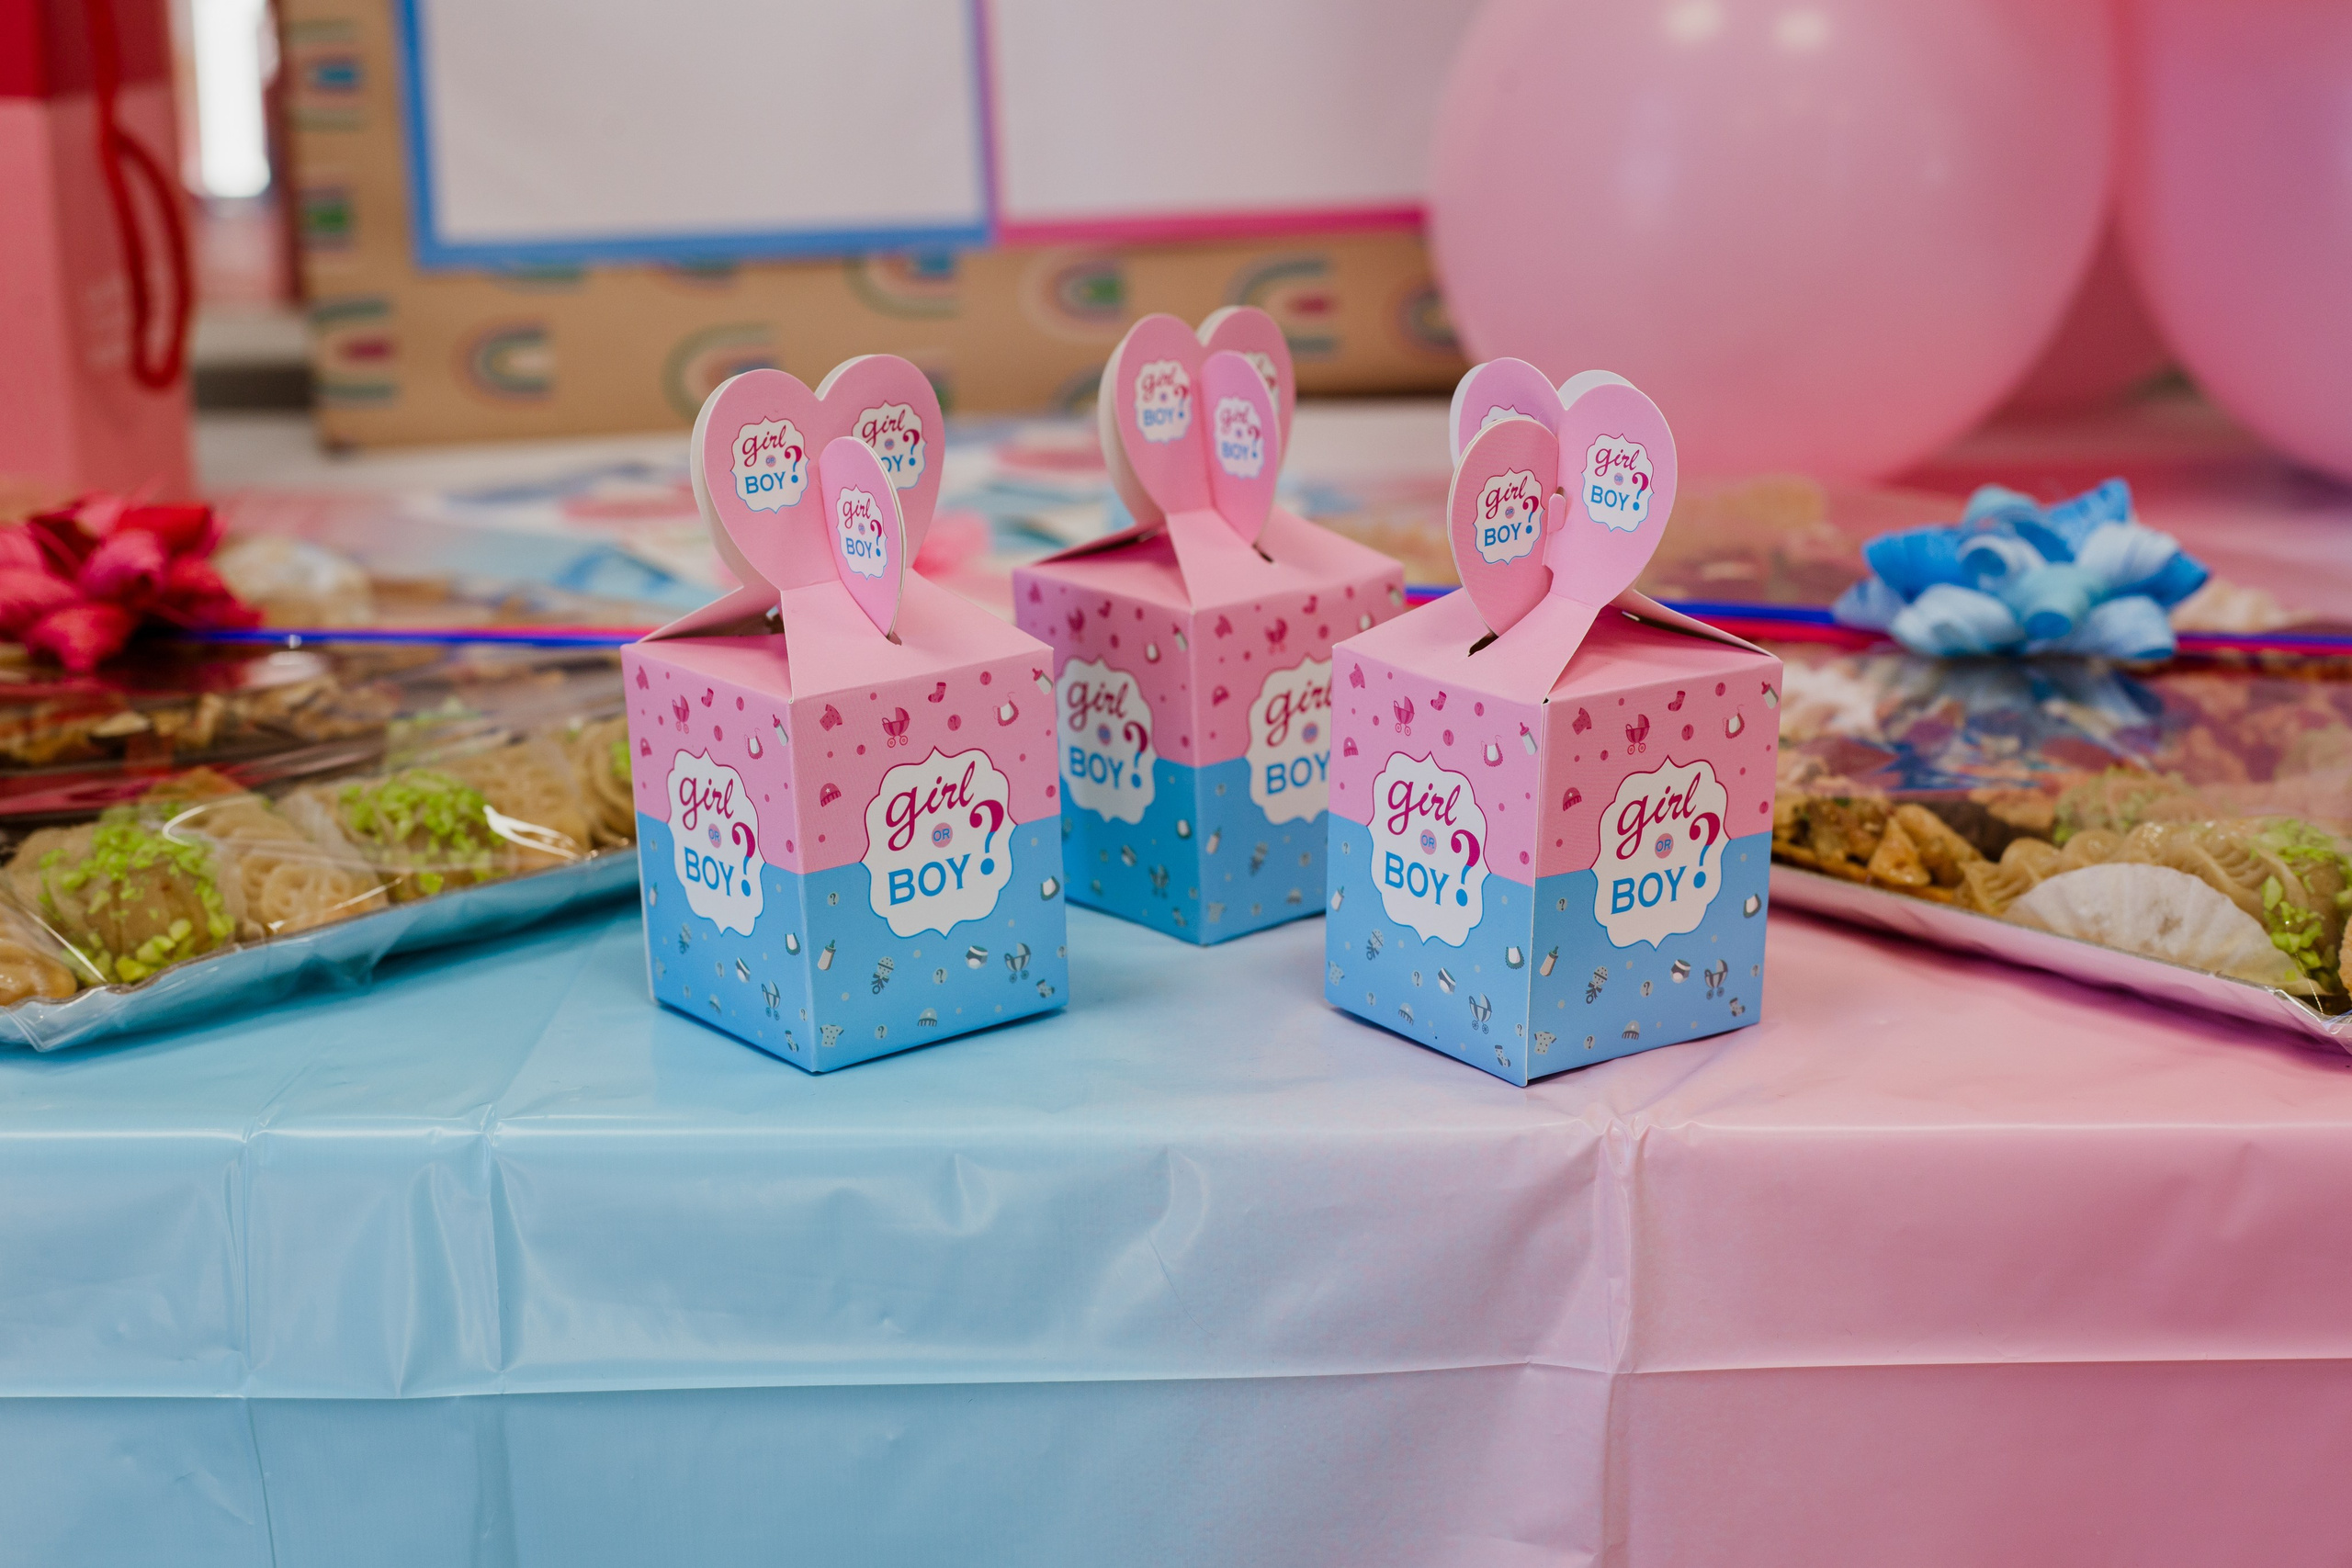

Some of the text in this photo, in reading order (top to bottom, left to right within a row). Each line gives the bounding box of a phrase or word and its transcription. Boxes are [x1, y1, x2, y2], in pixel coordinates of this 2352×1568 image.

[742, 425, 786, 467] girl
[862, 409, 905, 448] girl
[1594, 448, 1640, 477] girl
[842, 498, 871, 529] girl
[1485, 476, 1528, 519] girl
[1067, 682, 1129, 732] girl
[679, 777, 734, 830] girl
[885, 761, 975, 852] girl
[1387, 780, 1461, 835] girl
[1616, 772, 1701, 860] girl
[708, 829, 720, 842] OR
[933, 828, 951, 841] OR
[1420, 835, 1435, 849] OR
[1656, 839, 1671, 852] OR
